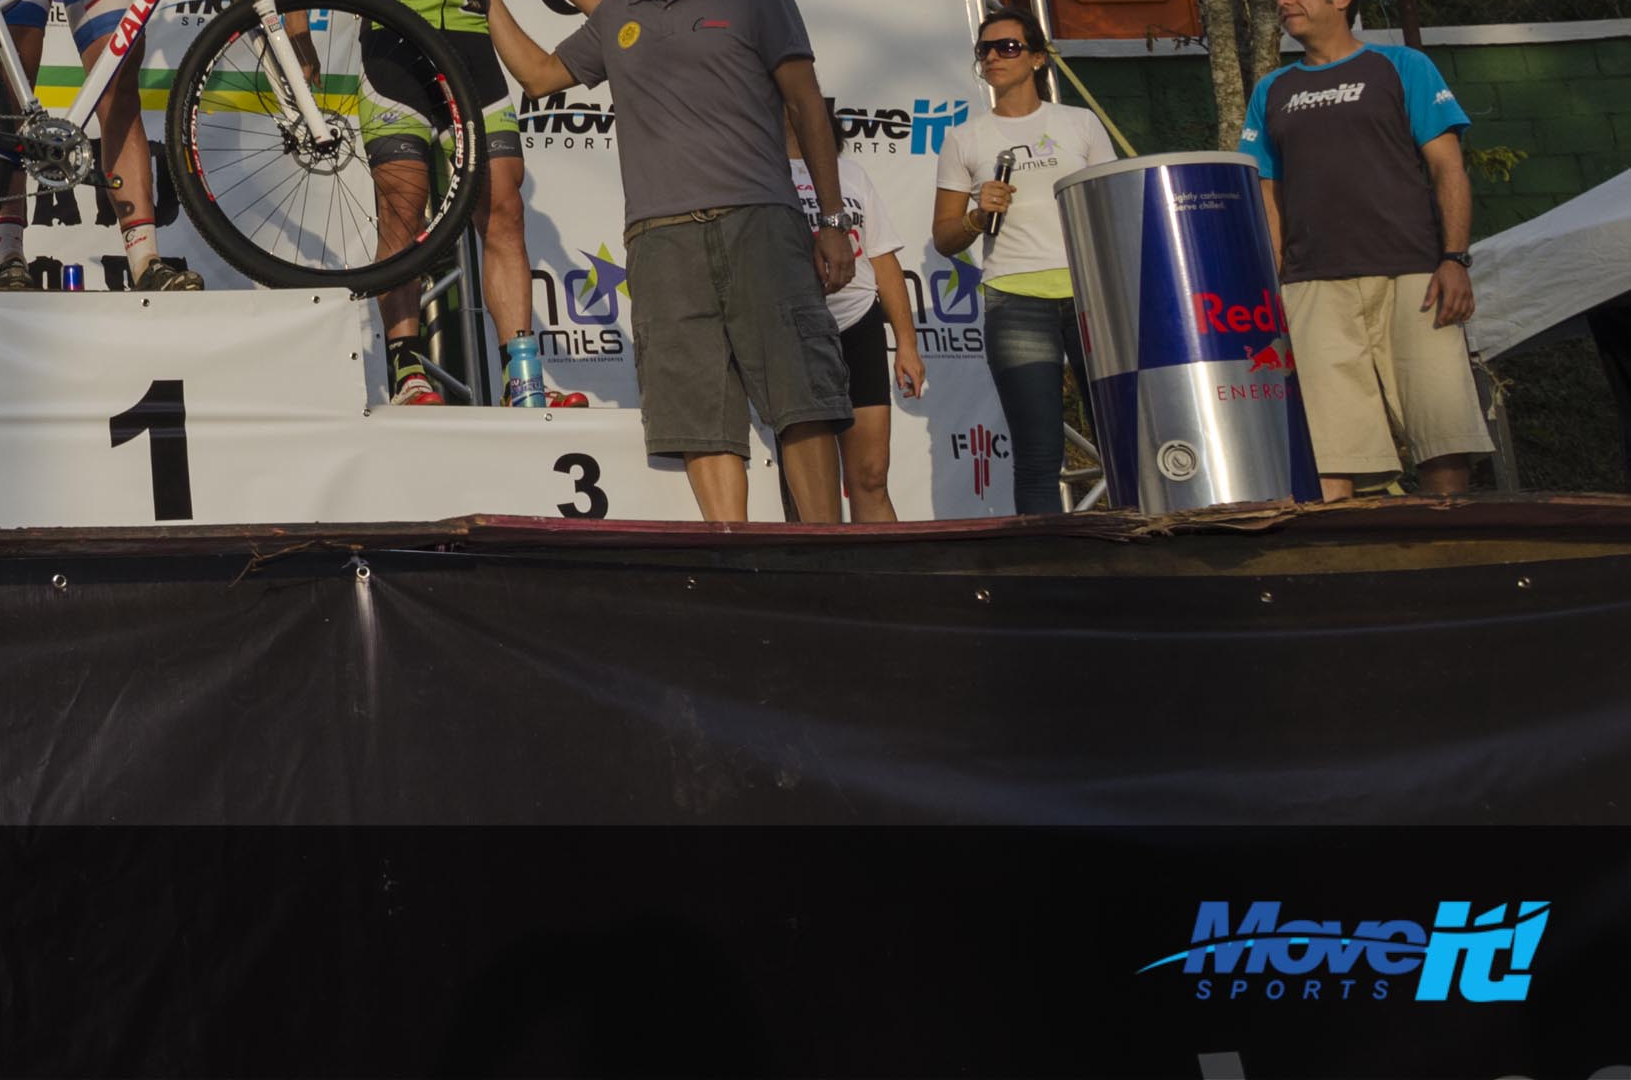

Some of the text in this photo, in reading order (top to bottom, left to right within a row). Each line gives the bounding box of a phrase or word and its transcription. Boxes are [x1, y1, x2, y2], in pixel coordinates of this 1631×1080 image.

[453, 121, 464, 169] CREST
[525, 137, 614, 150] SPORT
[852, 142, 897, 154] RTS
[440, 174, 462, 214] ZTR
[1174, 192, 1198, 204] ightly
[1192, 288, 1277, 335] Red
[537, 329, 624, 356] mits
[110, 379, 194, 521] 1
[553, 452, 609, 520] 3
